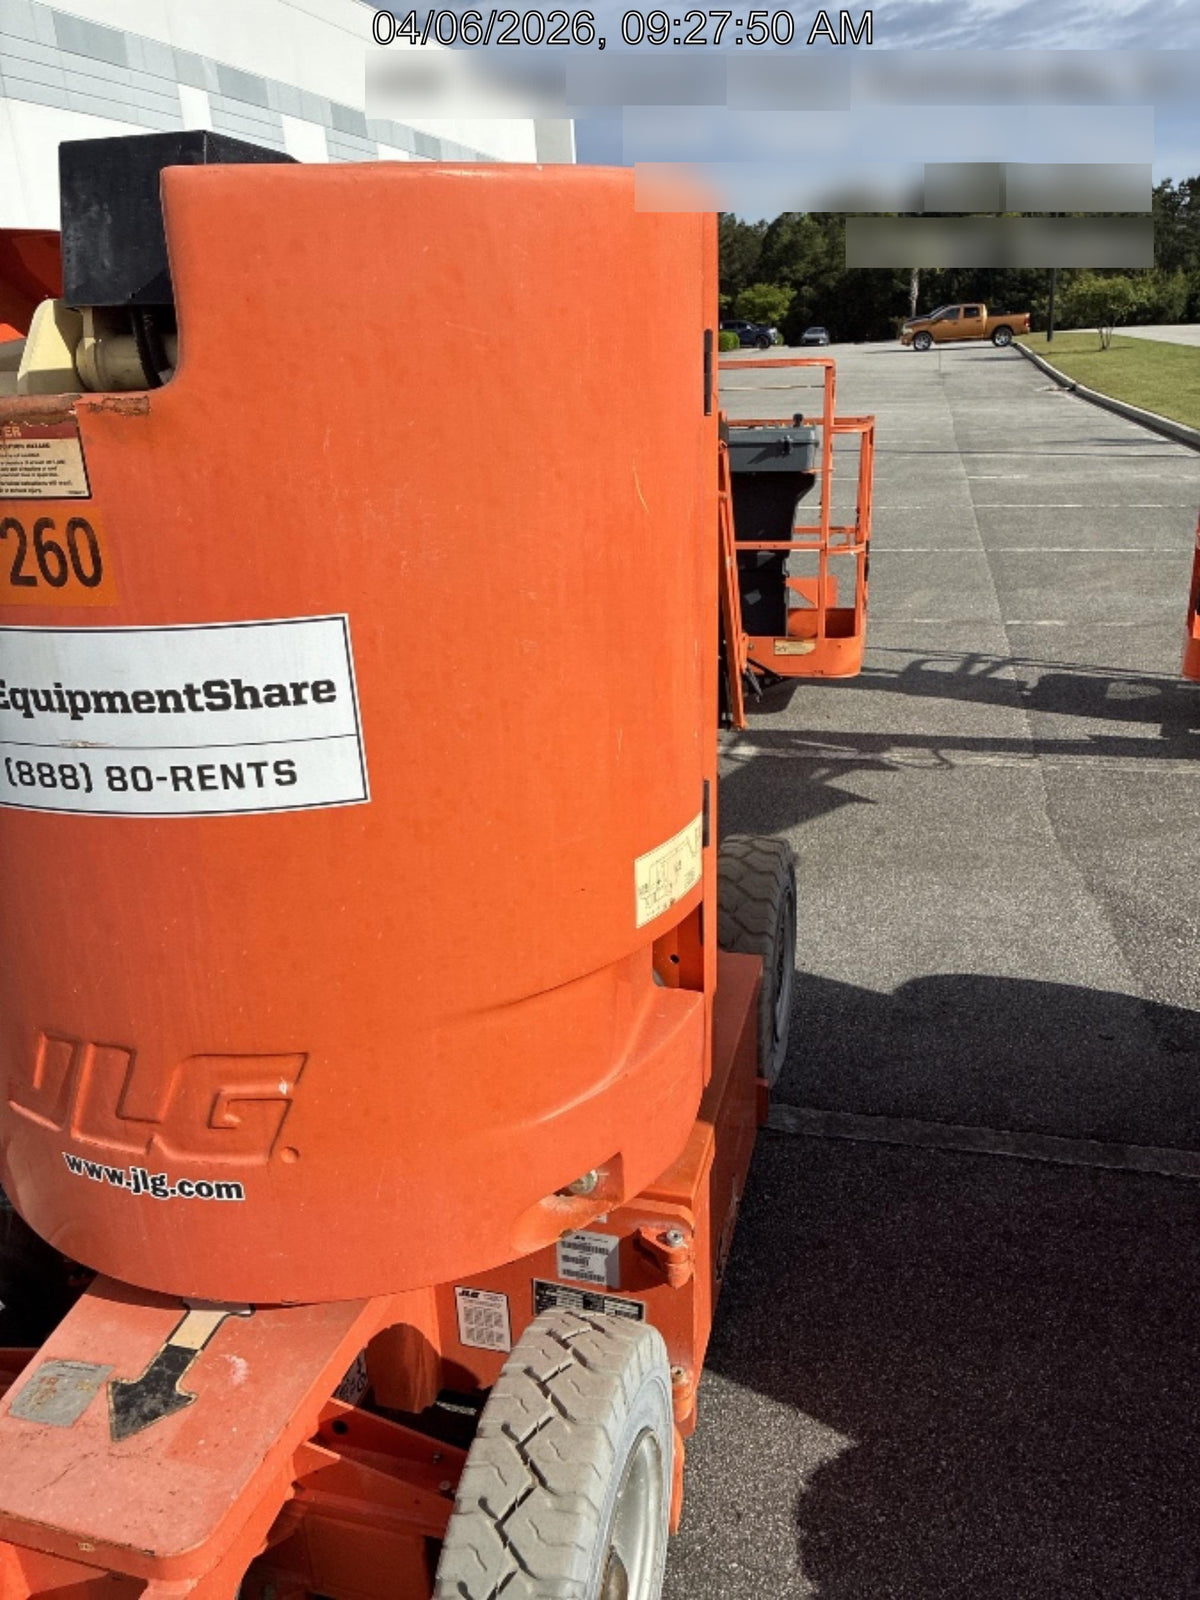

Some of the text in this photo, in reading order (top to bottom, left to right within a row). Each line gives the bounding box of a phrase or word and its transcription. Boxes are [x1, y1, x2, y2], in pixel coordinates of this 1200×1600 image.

[0, 516, 103, 588] 260
[5, 756, 298, 794] (888) 80-RENTS
[63, 1152, 245, 1201] www.jlg.com
